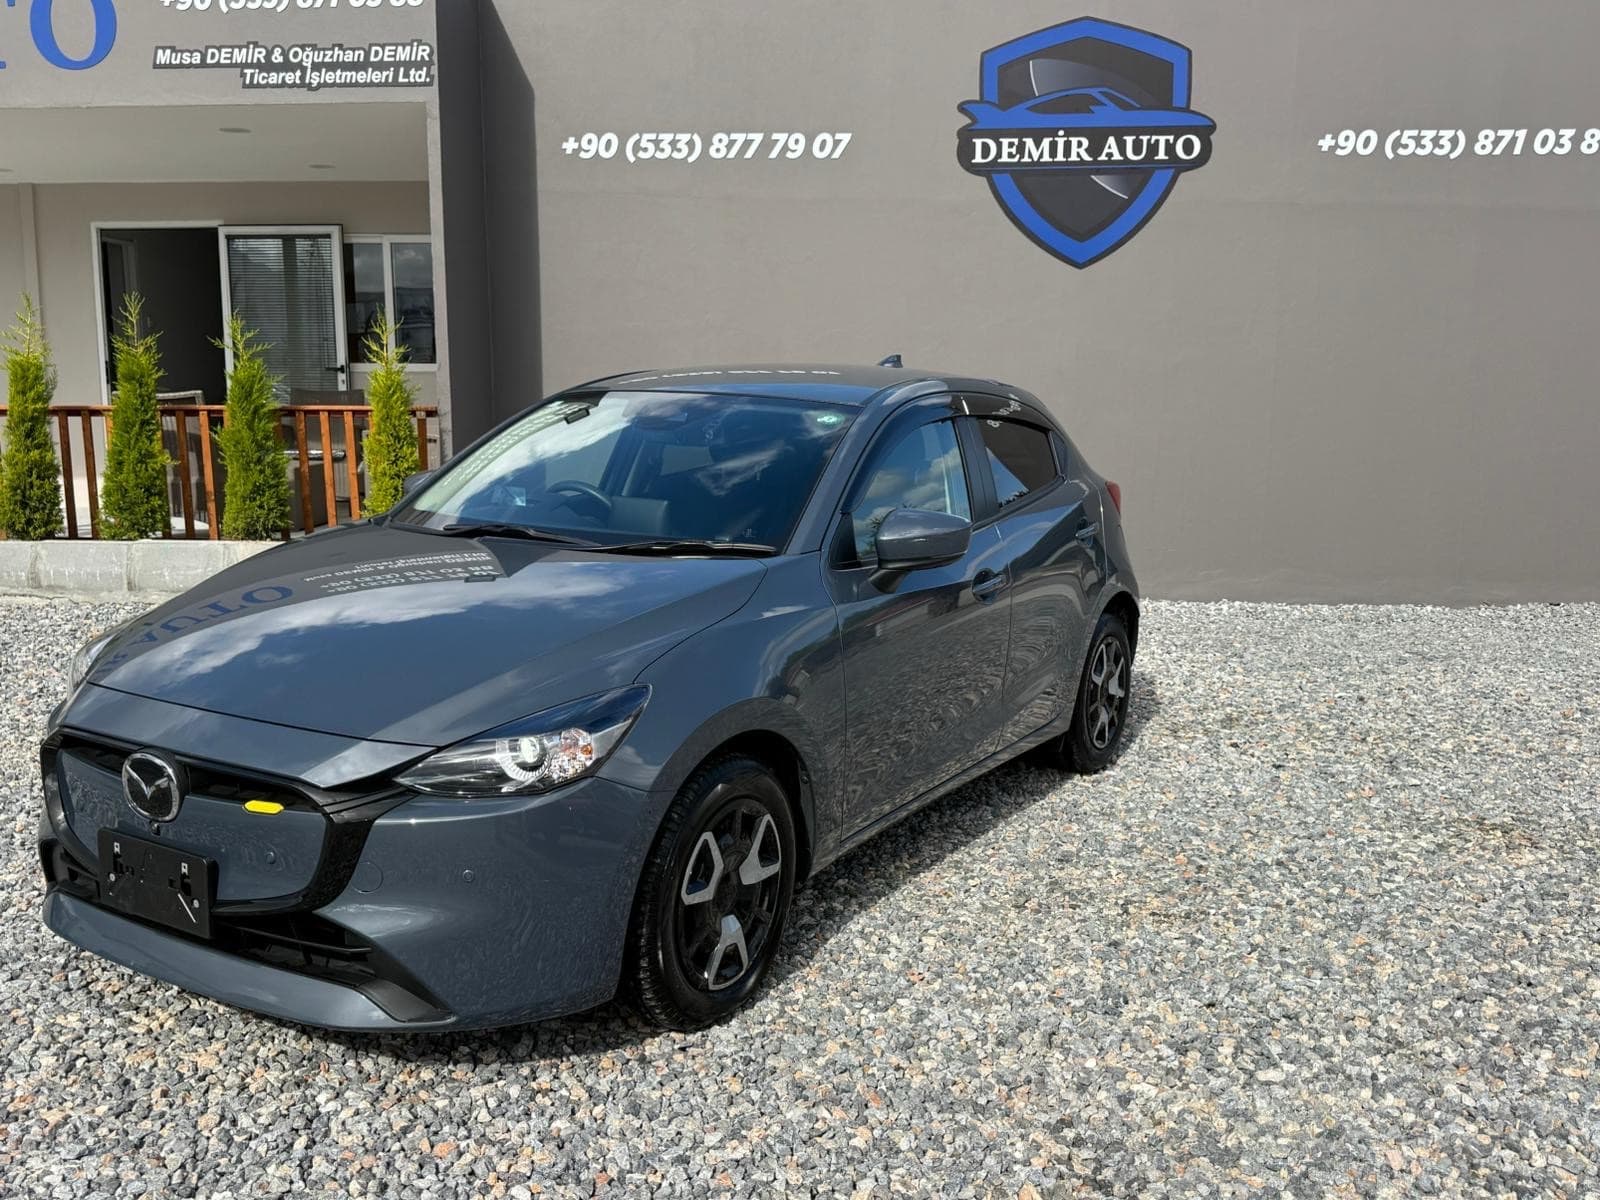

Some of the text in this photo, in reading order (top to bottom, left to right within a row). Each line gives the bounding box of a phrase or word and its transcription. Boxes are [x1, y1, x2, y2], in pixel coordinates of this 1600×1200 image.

[156, 42, 430, 67] Musa DEMİR & Oğuzhan DEMİR
[243, 69, 302, 85] Ticaret
[398, 66, 430, 83] Ltd.
[561, 132, 852, 164] +90 (533) 877 79 07
[971, 129, 1201, 163] DEMİR AUTO
[1317, 129, 1378, 156] +90
[1384, 129, 1466, 160] (533)
[1473, 128, 1528, 156] 871
[1533, 128, 1577, 155] 03
